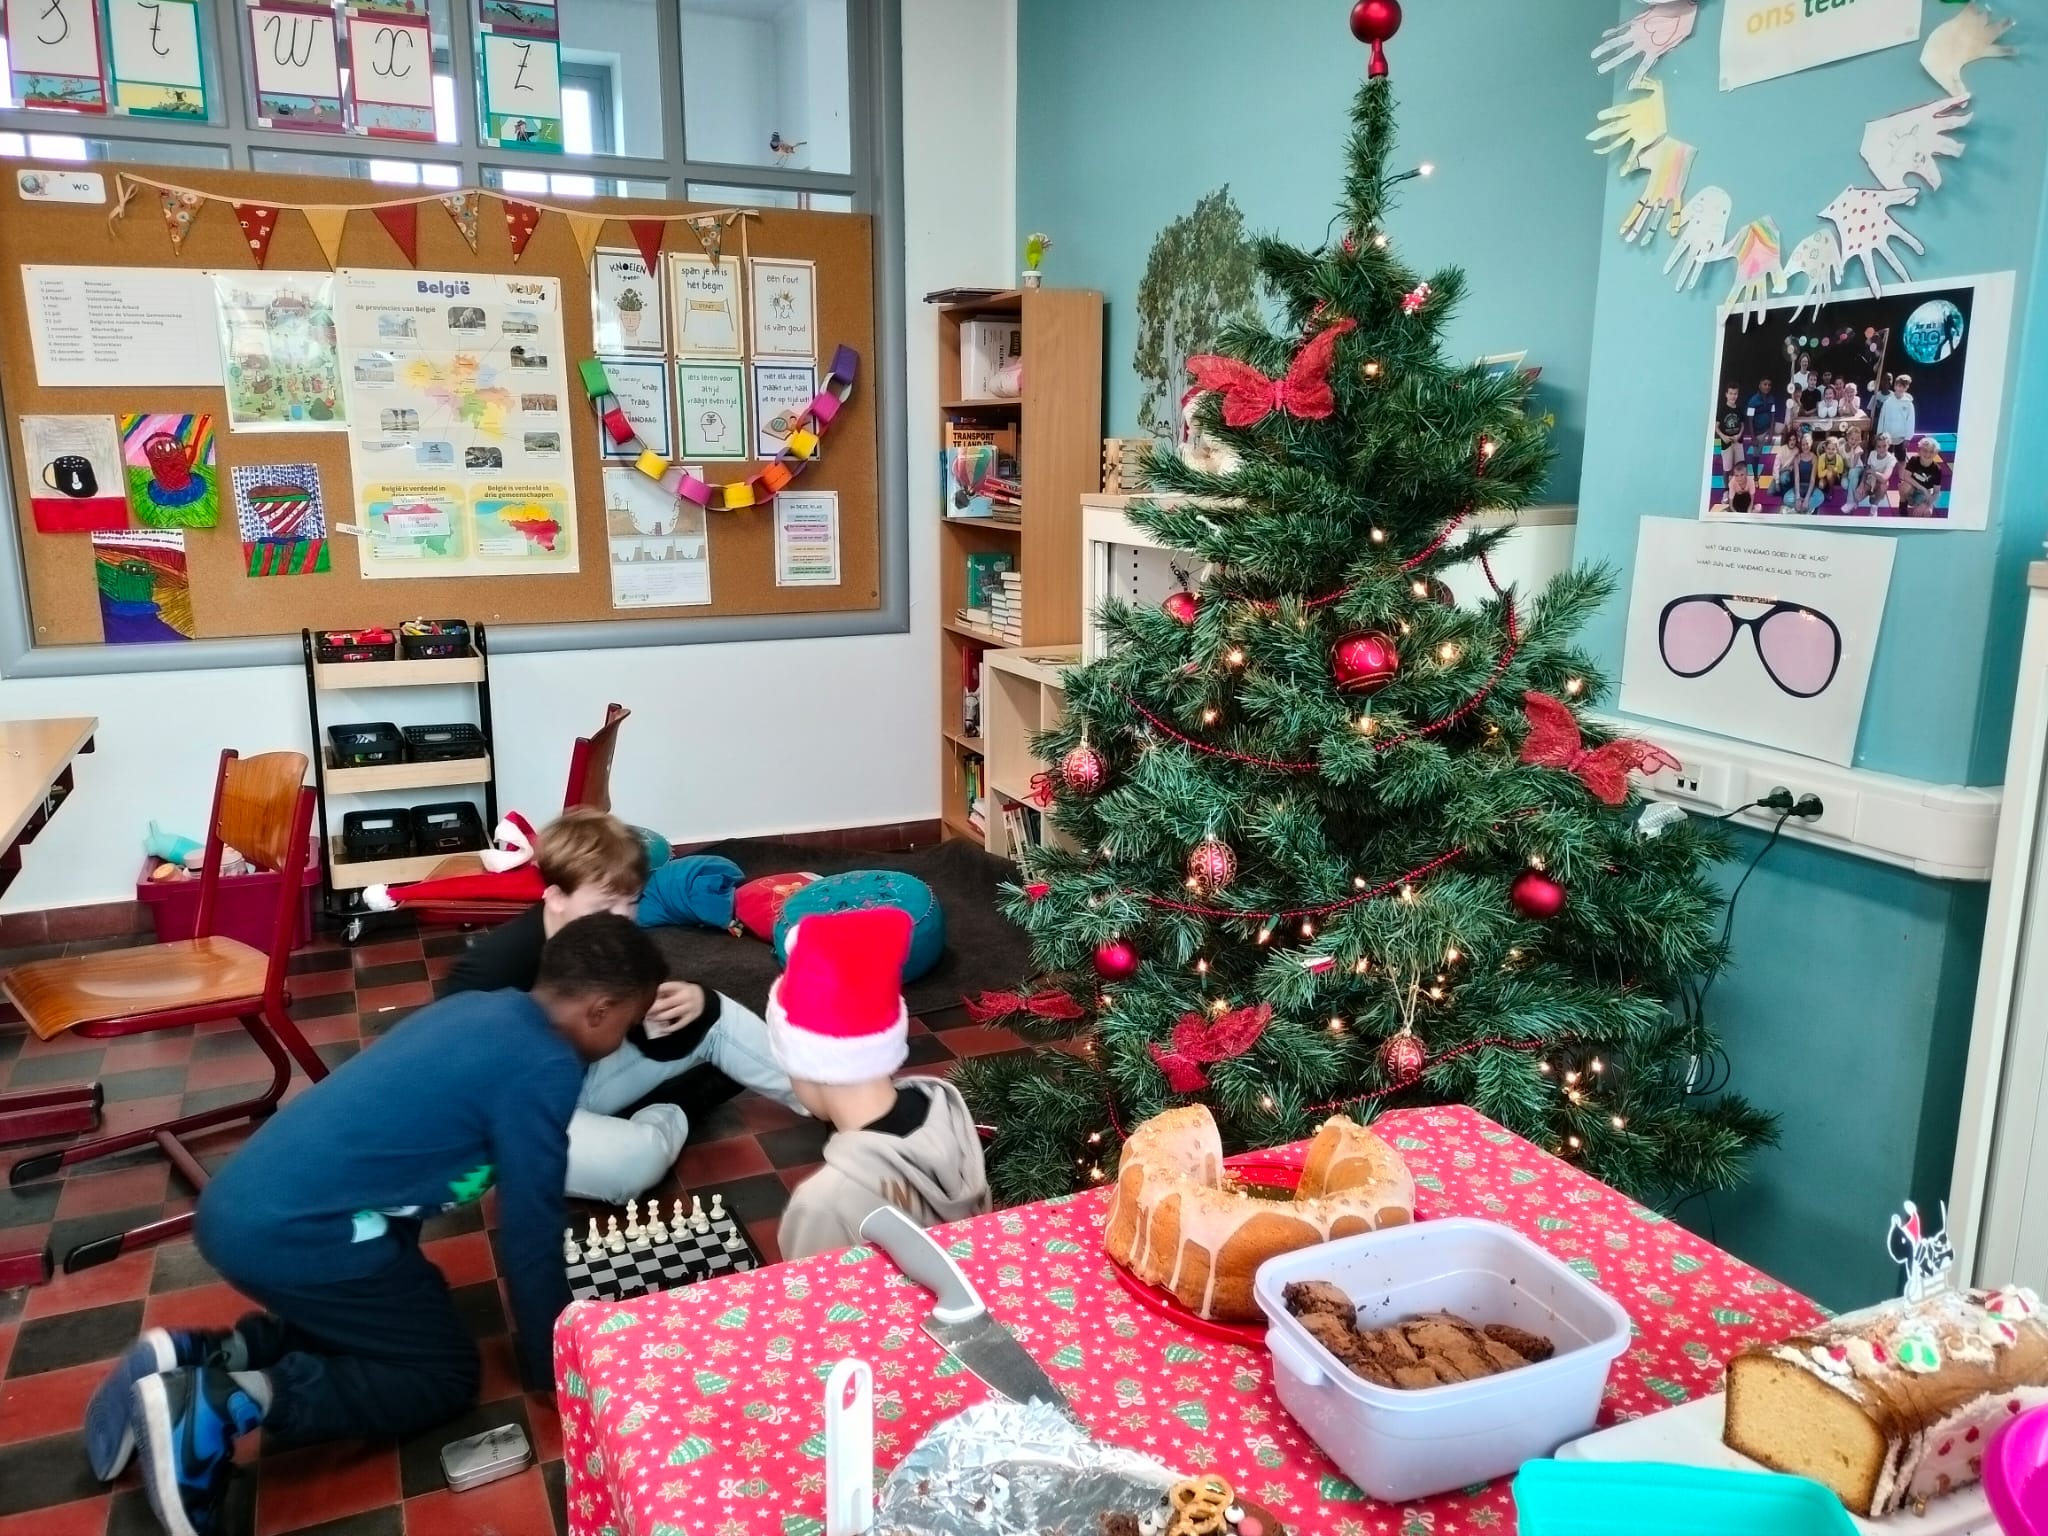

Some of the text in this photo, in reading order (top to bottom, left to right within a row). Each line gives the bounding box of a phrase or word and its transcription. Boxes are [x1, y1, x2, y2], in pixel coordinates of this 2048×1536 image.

[1746, 2, 1797, 35] ons
[72, 183, 90, 191] WO
[609, 261, 647, 274] KNOEIEN
[681, 267, 700, 278] span
[702, 267, 710, 280] je
[721, 268, 728, 277] is
[782, 274, 799, 284] fout
[417, 280, 470, 298] België
[687, 280, 724, 294] het begin
[366, 304, 400, 312] provincies
[773, 324, 787, 332] van
[788, 324, 806, 336] goud
[642, 383, 658, 392] knap
[631, 398, 650, 409] Traag
[953, 432, 995, 441] TRANSPORT
[382, 485, 402, 493] België
[1743, 547, 1770, 556] VANDAAG
[1737, 563, 1764, 572] VANDAAG
[1777, 568, 1792, 576] KLAS
[1795, 569, 1817, 578] TROTS
